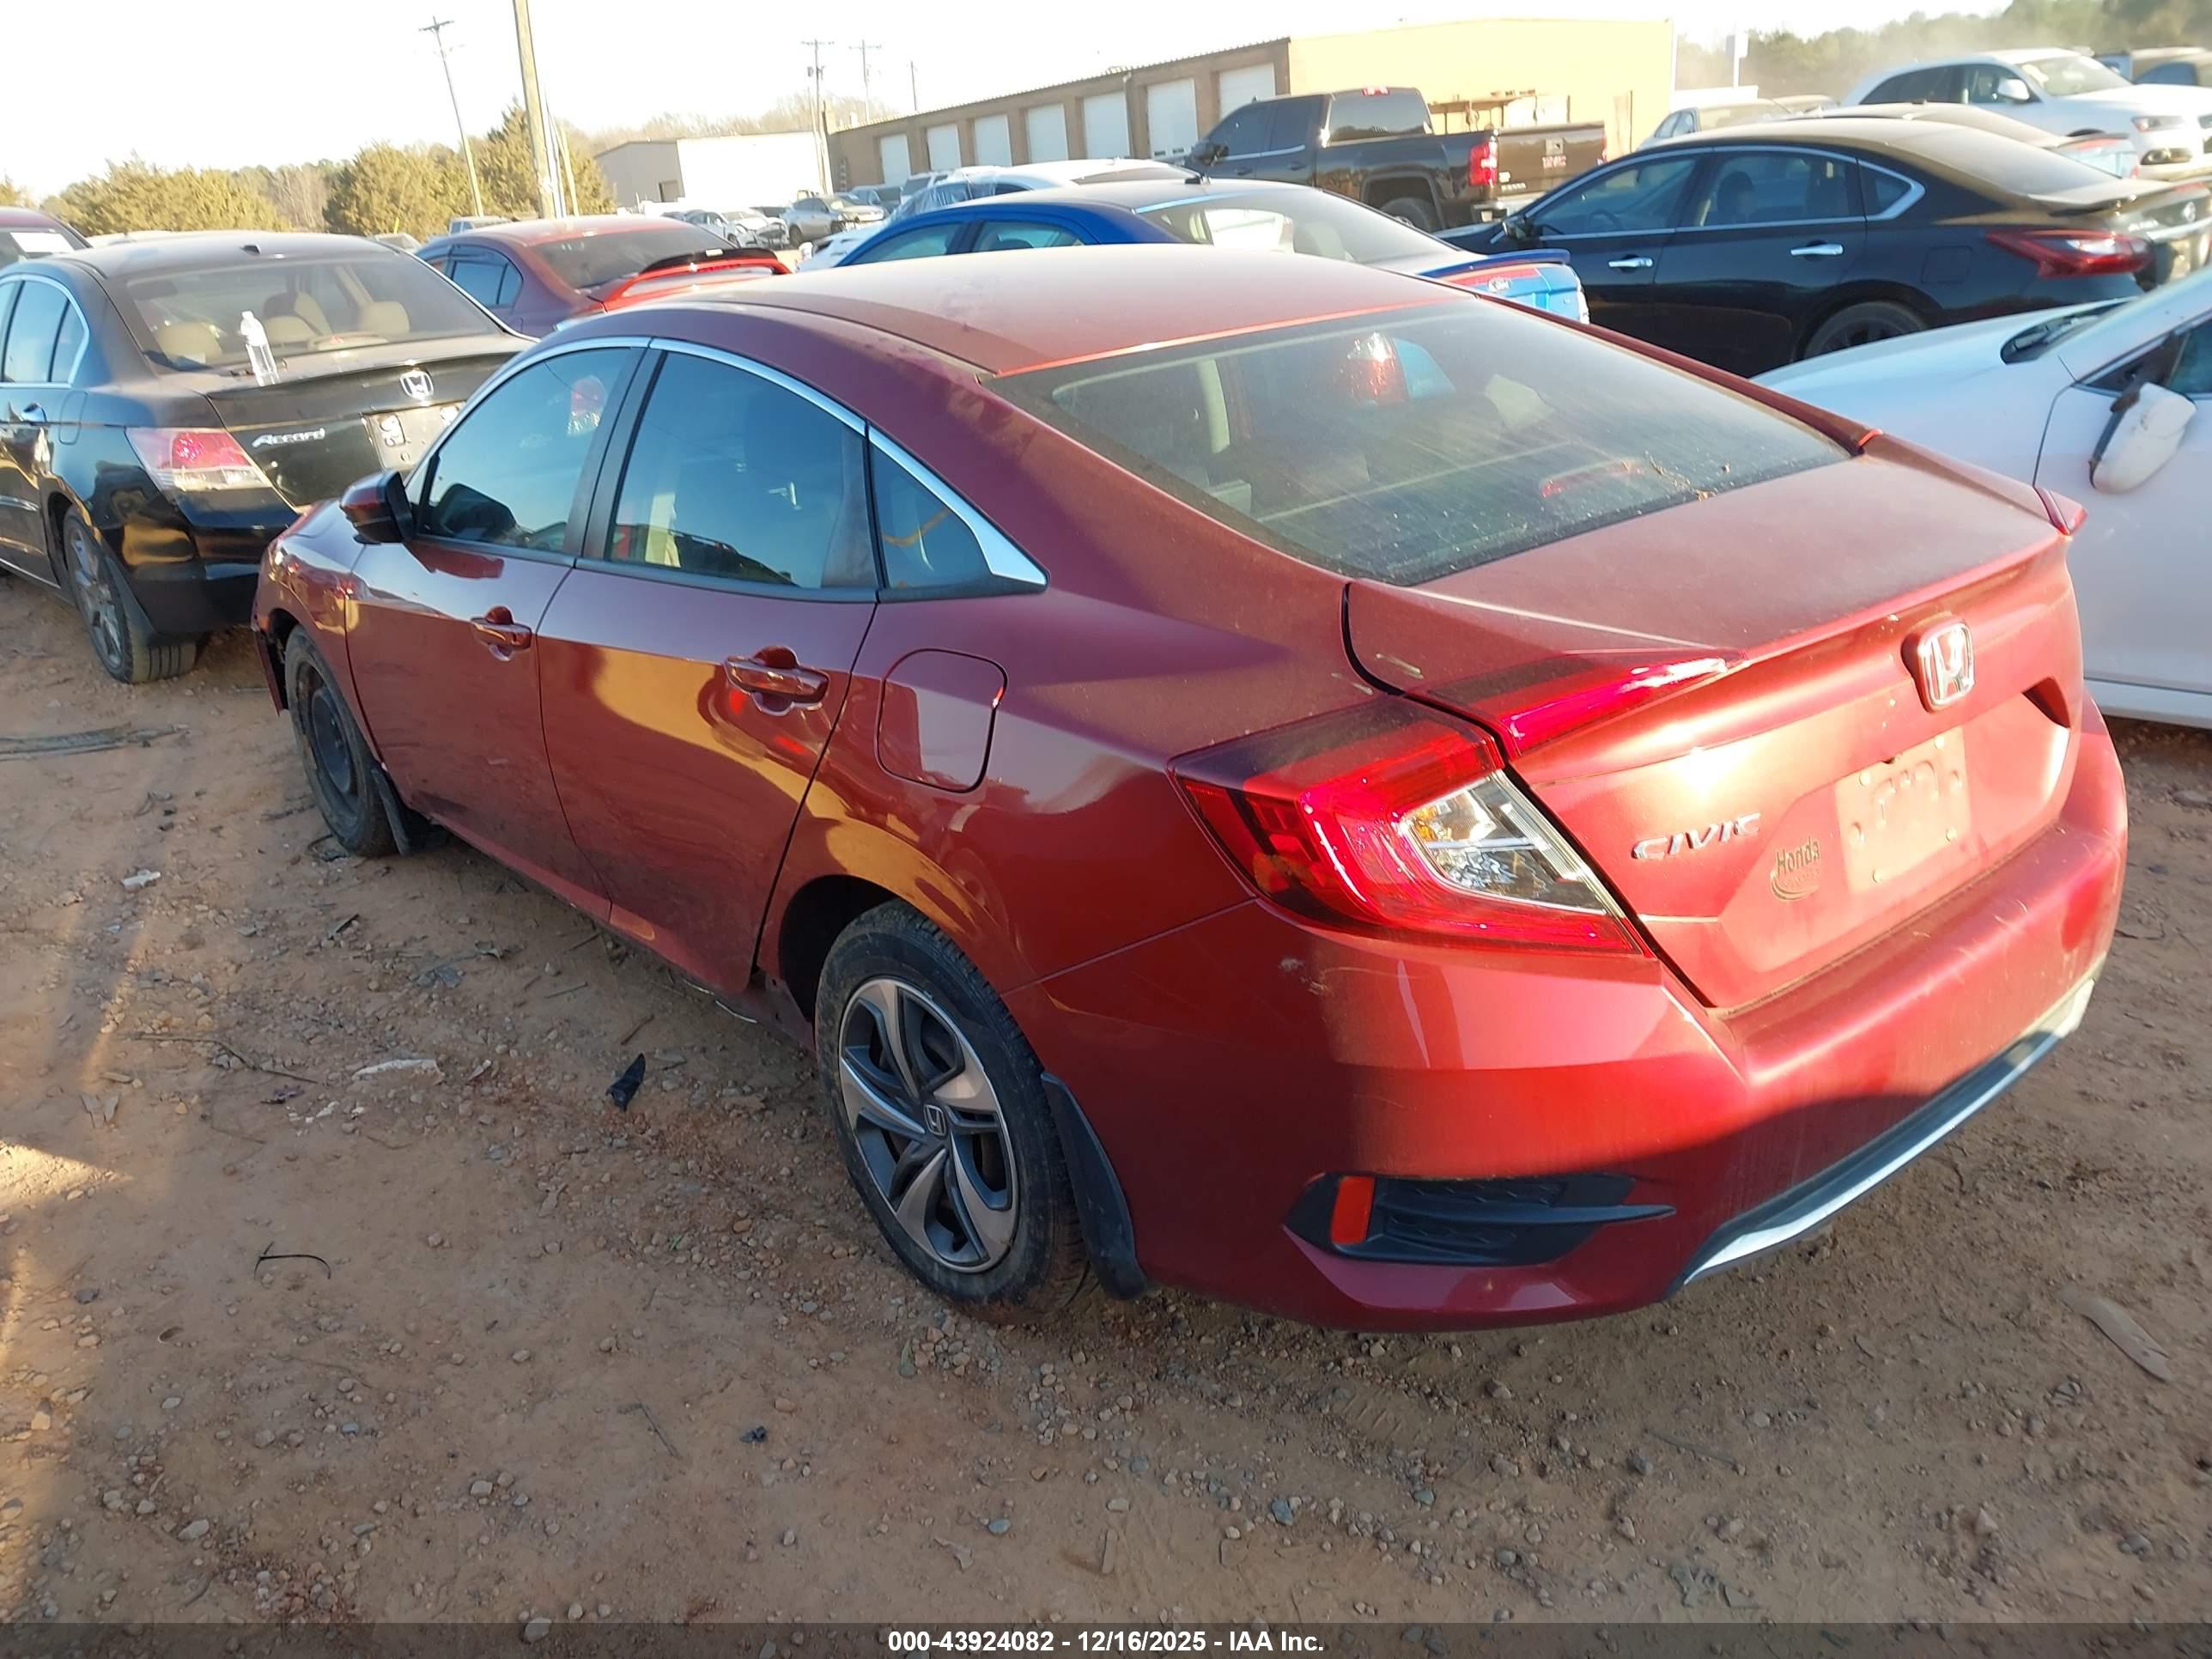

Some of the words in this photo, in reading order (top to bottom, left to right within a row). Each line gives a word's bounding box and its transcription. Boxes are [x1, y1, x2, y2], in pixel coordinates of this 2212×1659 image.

[252, 427, 325, 447] Accord
[1631, 811, 1760, 860] CIVIC
[1776, 836, 1820, 878] Honda
